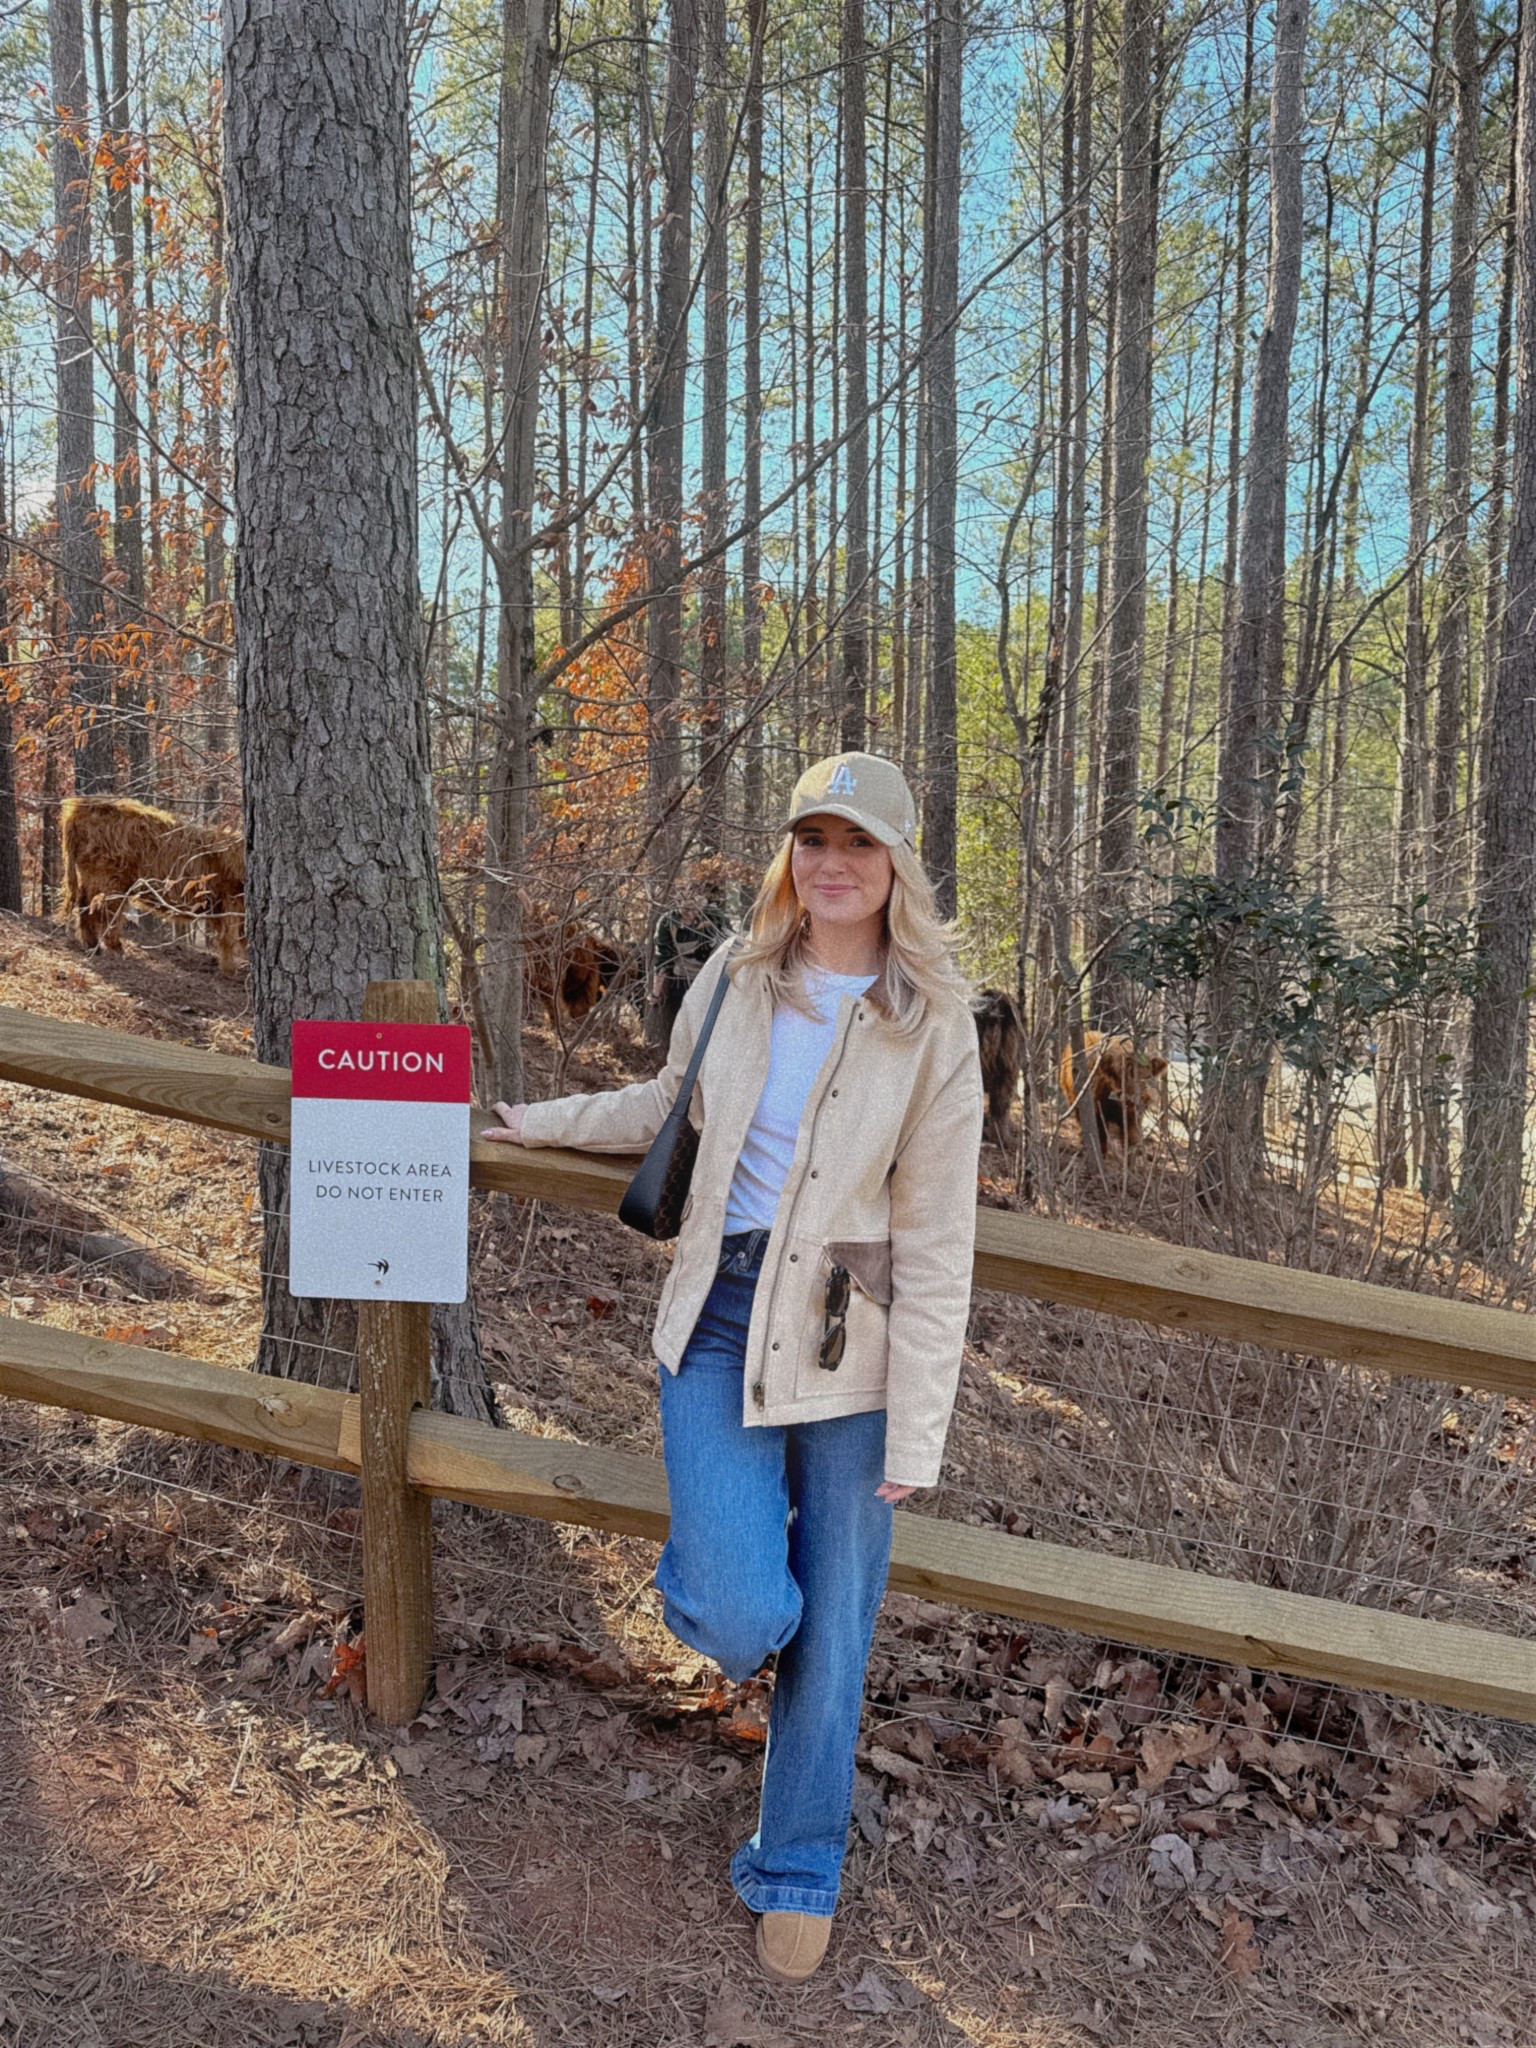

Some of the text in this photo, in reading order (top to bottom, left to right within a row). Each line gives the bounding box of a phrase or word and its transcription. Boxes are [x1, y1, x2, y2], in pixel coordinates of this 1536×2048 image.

[828, 763, 857, 795] LA
[318, 1048, 443, 1073] CAUTION
[309, 1160, 452, 1178] LIVESTOCK AREA
[316, 1185, 443, 1202] DO NOT ENTER
